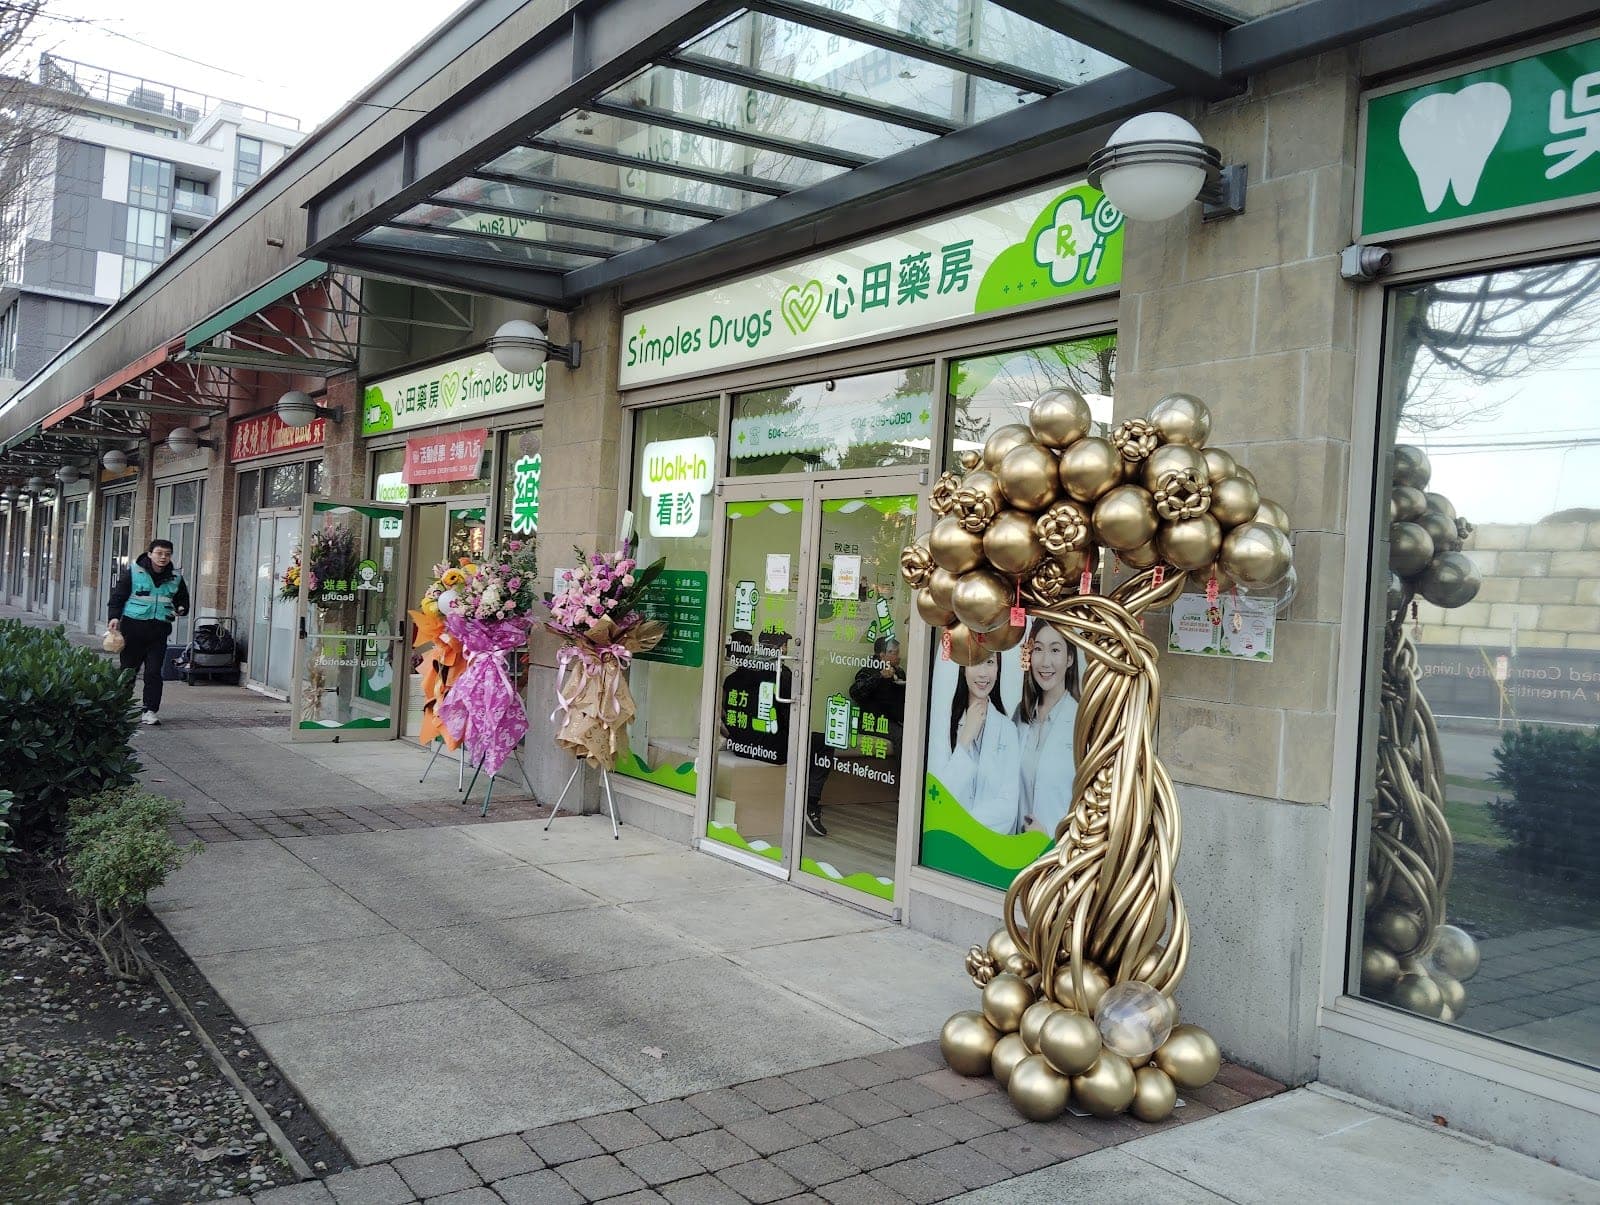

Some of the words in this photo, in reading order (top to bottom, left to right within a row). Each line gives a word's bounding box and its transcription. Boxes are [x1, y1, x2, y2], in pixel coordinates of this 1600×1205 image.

[825, 239, 975, 320] 心田藥房
[627, 325, 702, 367] Simples
[708, 308, 773, 349] Drugs
[395, 380, 440, 416] 心田藥房
[461, 369, 508, 401] Simples
[656, 490, 695, 526] 看診
[731, 640, 752, 654] Minor
[829, 652, 891, 671] Vaccinations
[862, 711, 889, 735] 驗血
[726, 739, 777, 761] Prescriptions
[814, 752, 831, 768] Lab
[833, 756, 851, 775] Test
[852, 760, 895, 785] Referrals
